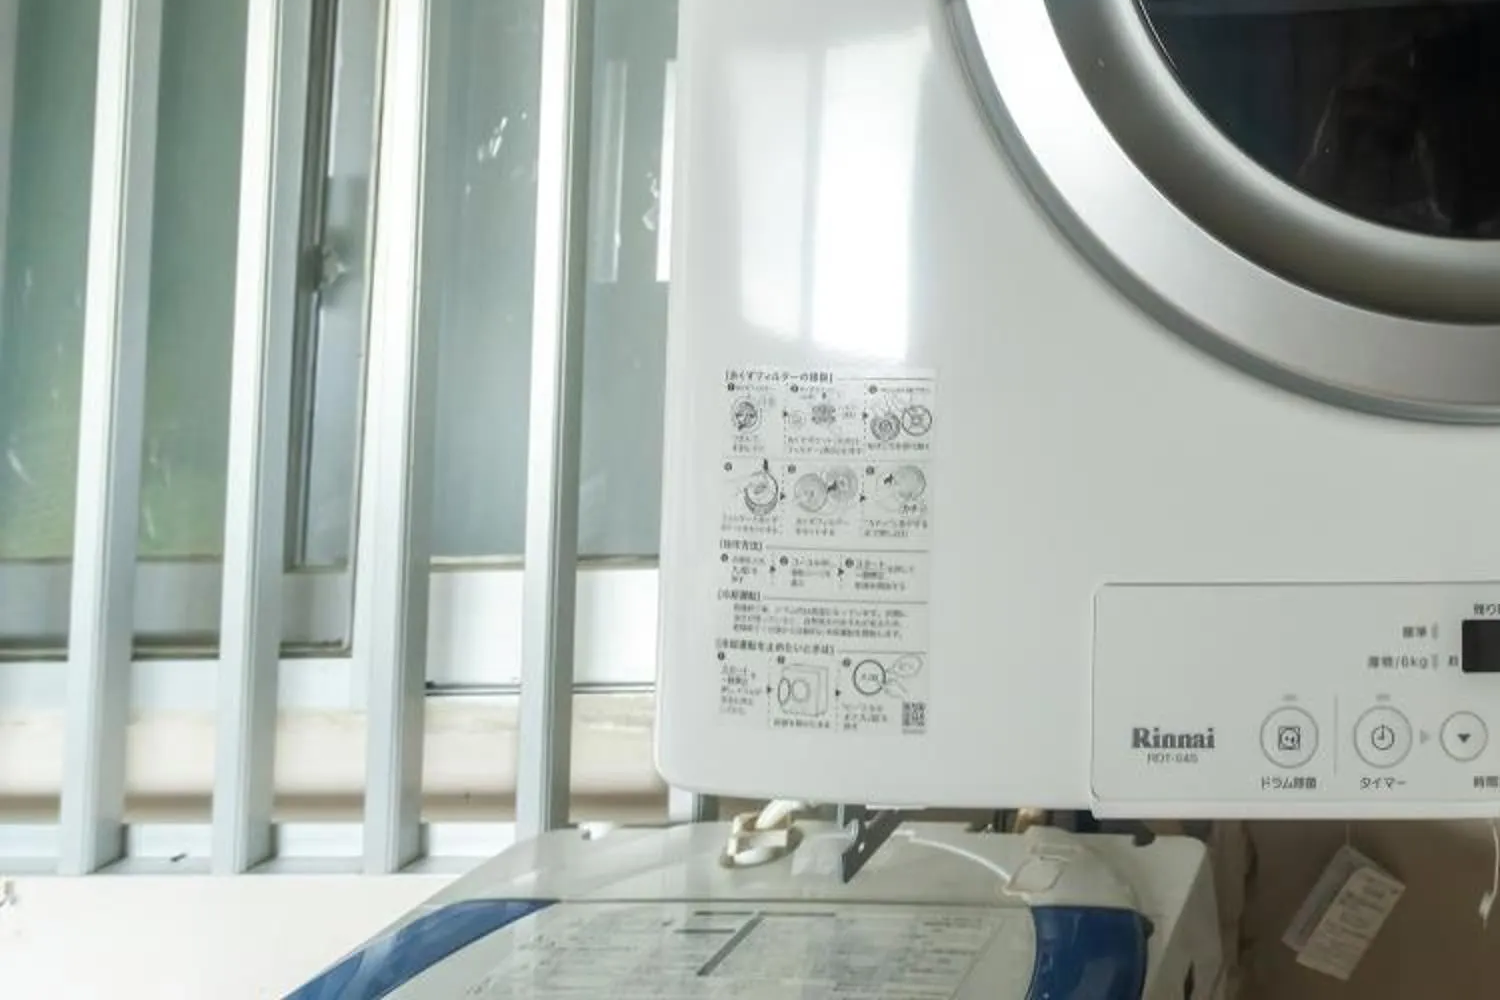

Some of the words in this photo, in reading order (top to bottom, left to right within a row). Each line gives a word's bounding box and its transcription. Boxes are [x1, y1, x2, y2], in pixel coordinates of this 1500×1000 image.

[1131, 727, 1215, 749] Rinnai
[1360, 776, 1408, 790] タイマー
